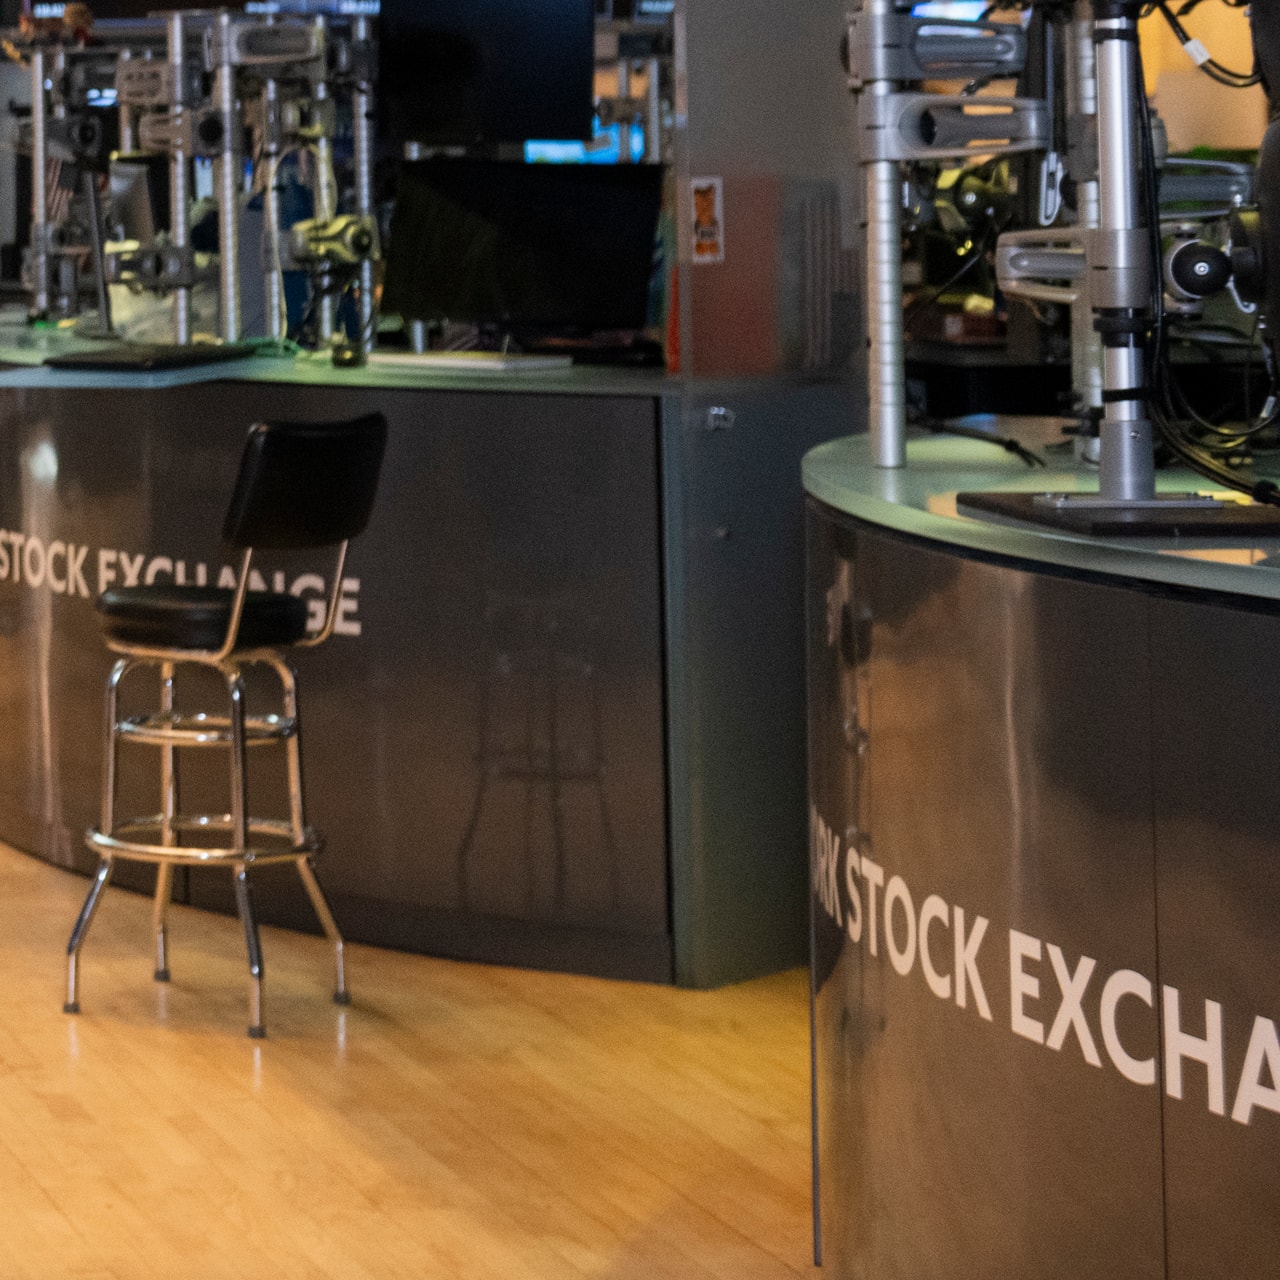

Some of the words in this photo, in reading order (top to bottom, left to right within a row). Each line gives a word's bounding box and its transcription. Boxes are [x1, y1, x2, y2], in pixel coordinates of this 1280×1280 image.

[814, 806, 843, 929] RK
[846, 846, 994, 1023] STOCK
[1009, 928, 1280, 1126] EXCHA
